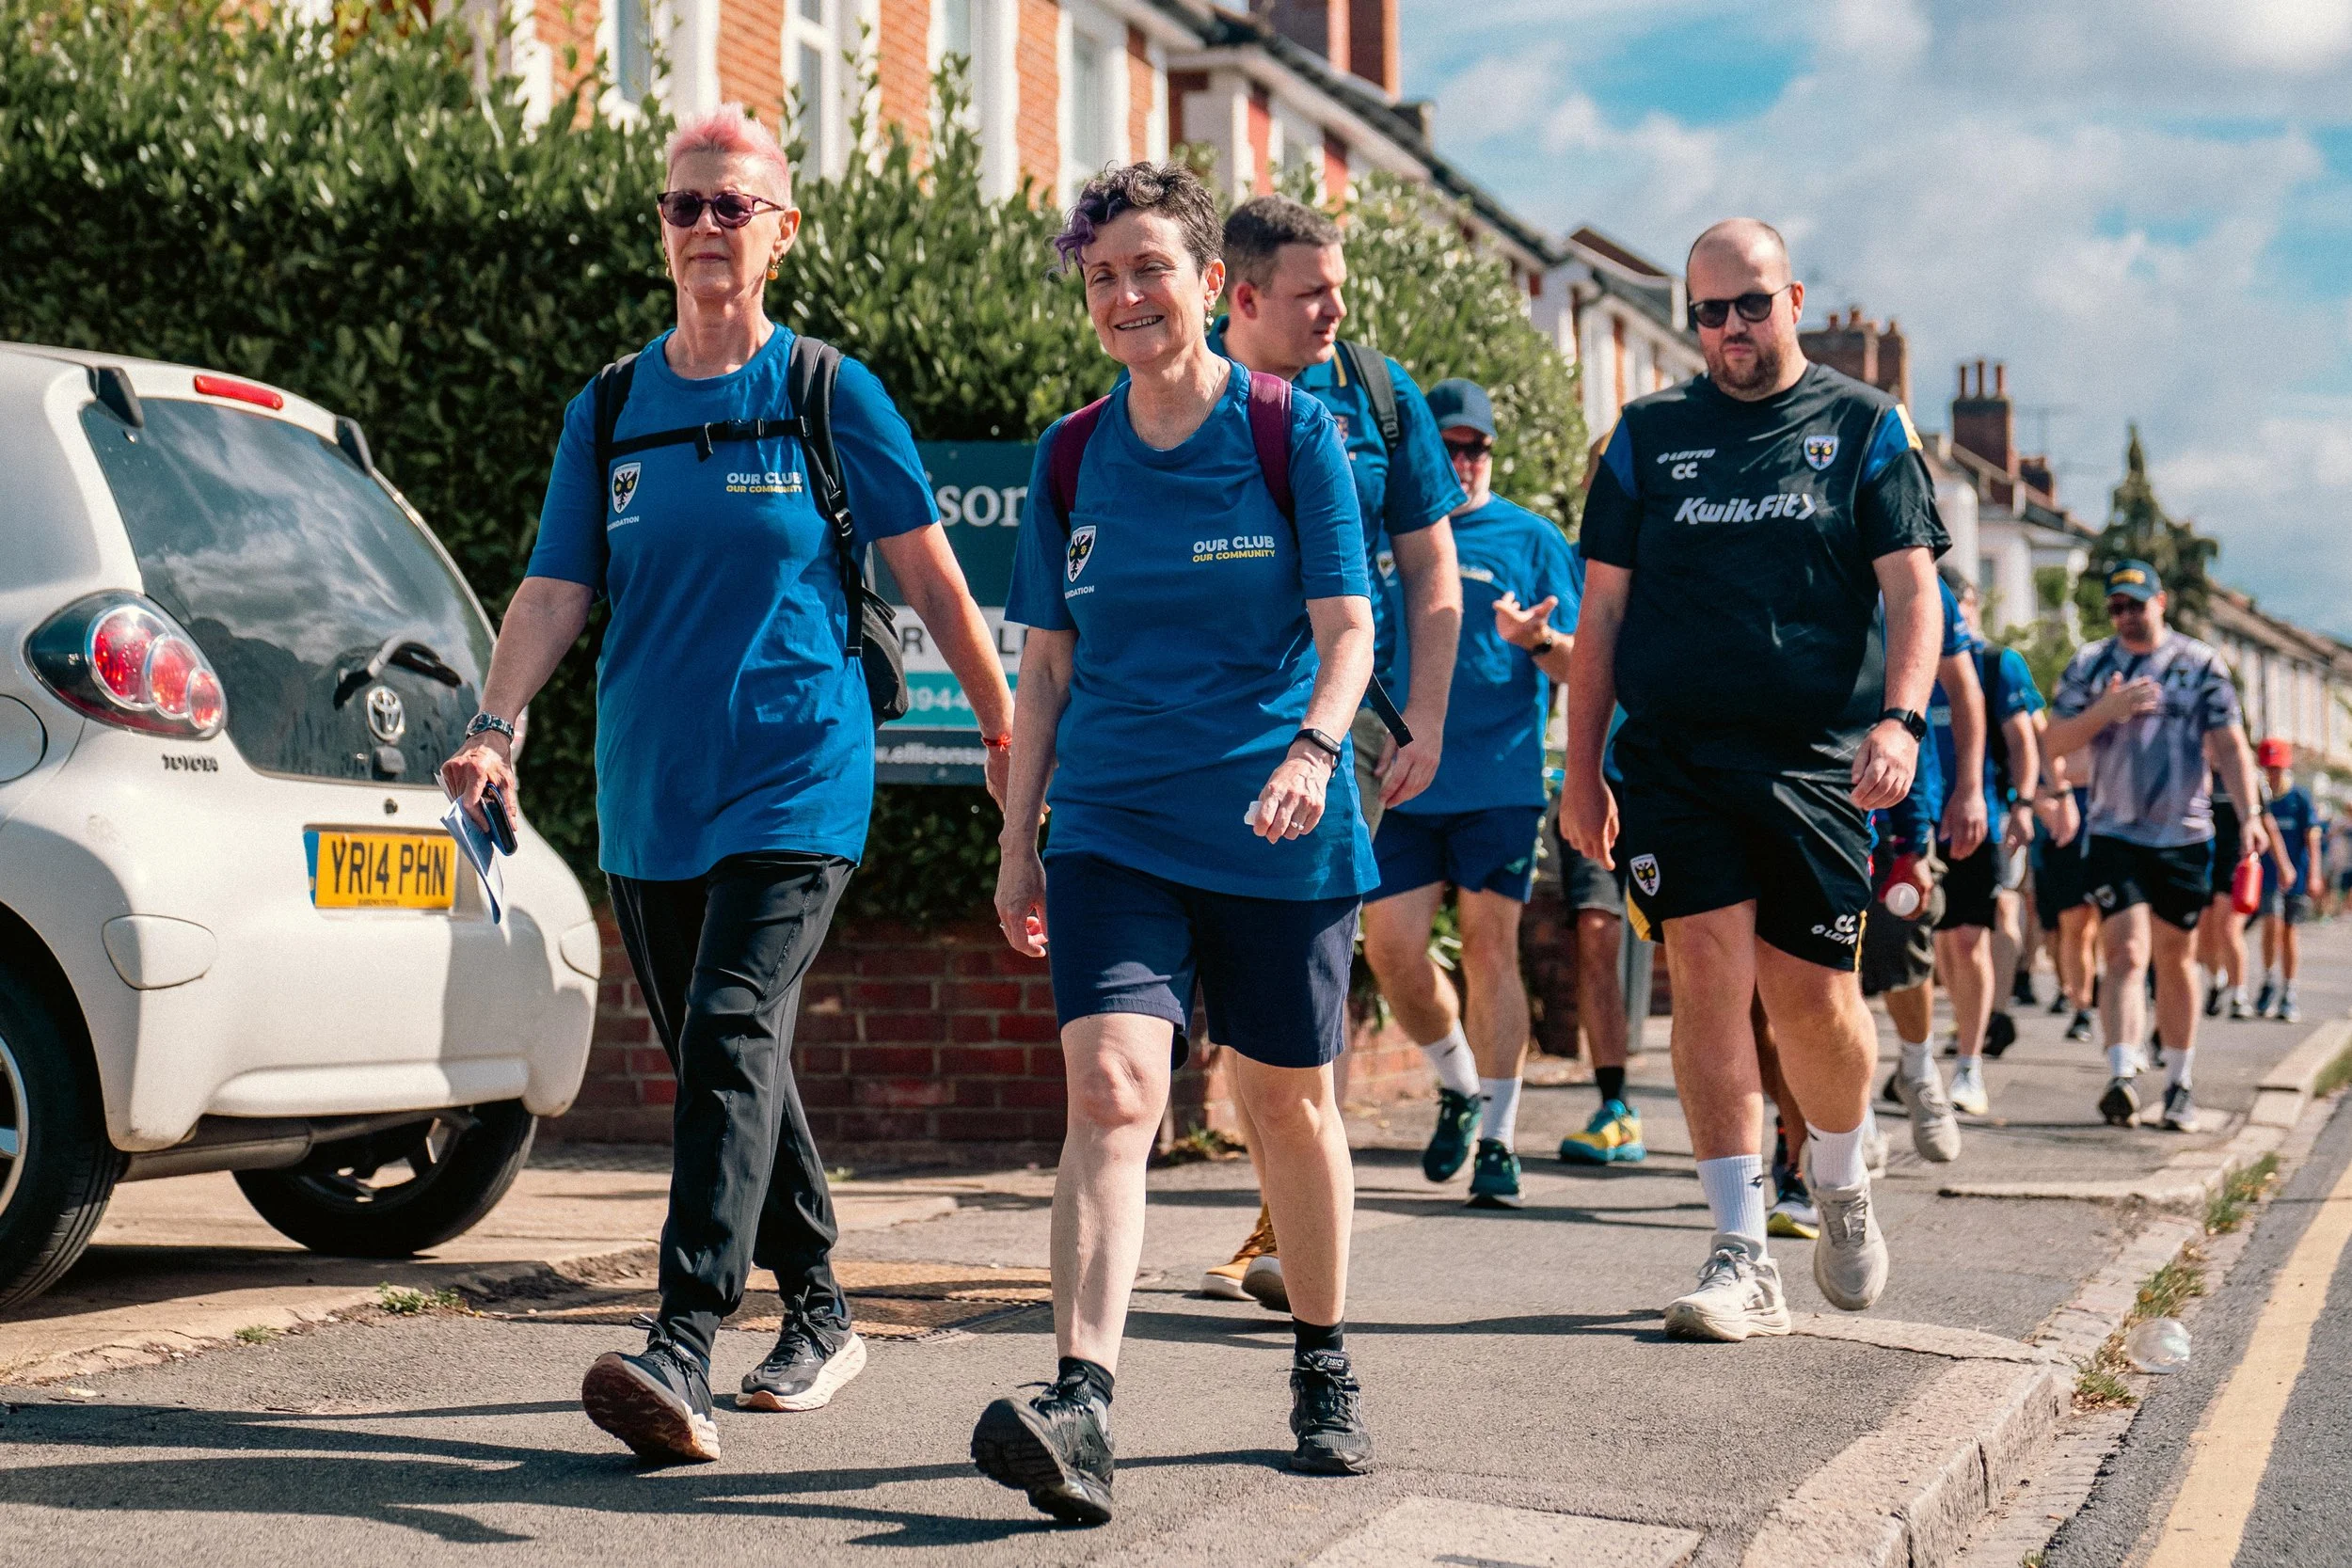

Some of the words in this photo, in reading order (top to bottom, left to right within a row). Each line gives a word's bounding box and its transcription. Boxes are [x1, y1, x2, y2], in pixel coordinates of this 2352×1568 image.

[726, 472, 761, 484] OUR
[764, 471, 803, 484] CLUB
[1671, 461, 1698, 481] CC
[725, 484, 747, 493] OUR
[749, 484, 803, 494] COMMUNITY
[1193, 539, 1229, 554] OUR
[1232, 535, 1275, 549] CLUB
[1192, 553, 1214, 562] OUR
[1216, 549, 1276, 560] COMMUNITY
[161, 752, 219, 772] TOYOTA
[331, 840, 389, 895] YR14
[398, 843, 448, 896] PHN
